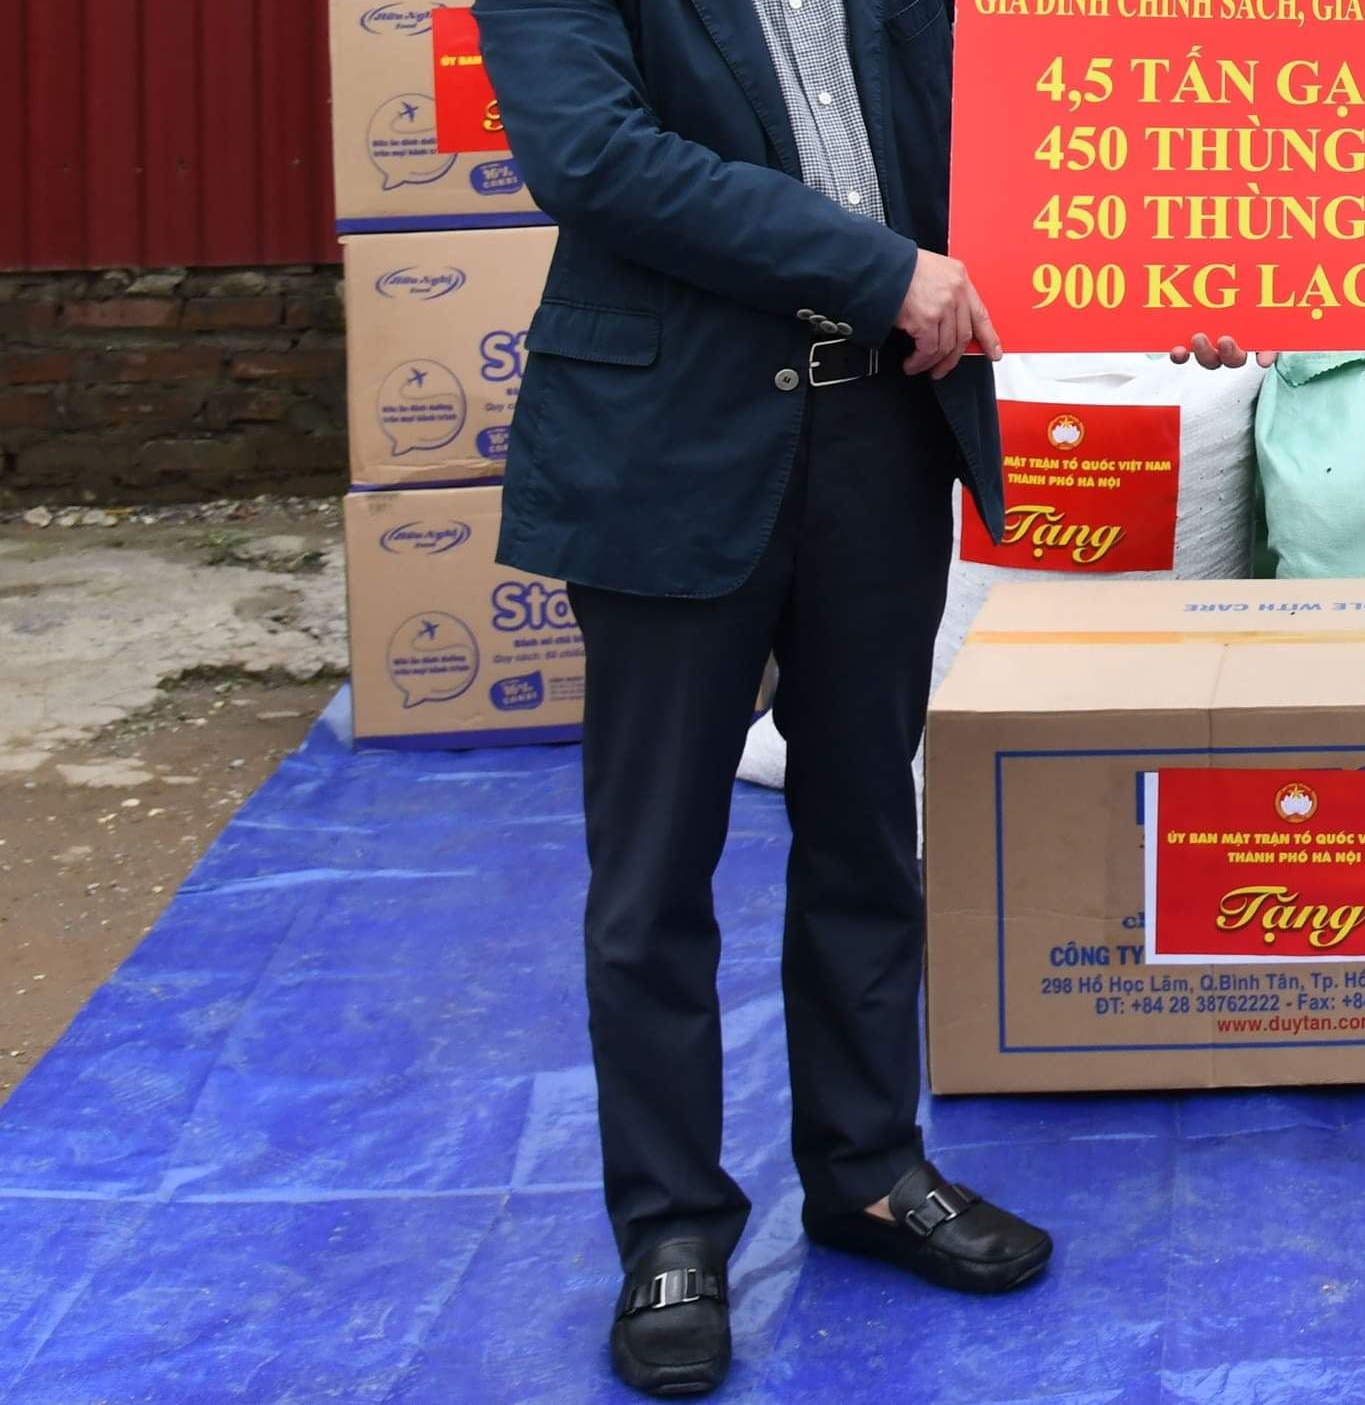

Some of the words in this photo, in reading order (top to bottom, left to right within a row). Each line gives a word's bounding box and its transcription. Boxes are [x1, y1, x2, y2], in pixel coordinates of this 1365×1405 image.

[1036, 56, 1113, 112] 4,5
[1131, 45, 1259, 104] TẤN
[1034, 125, 1128, 171] 450
[1033, 195, 1126, 240] 450
[1032, 264, 1125, 309] 900
[1143, 264, 1240, 308] KG
[1001, 504, 1121, 563] Tặng
[1184, 603, 1249, 612] CARE
[1258, 603, 1322, 611] WITH
[1189, 832, 1218, 844] BAN
[1315, 830, 1355, 845] QUỐC
[1227, 851, 1275, 863] THÀNH
[1278, 849, 1309, 863] PHỐ
[1311, 851, 1332, 863] HÀ
[1335, 850, 1362, 865] NỘI
[1216, 885, 1365, 947] Tặng
[1050, 941, 1110, 966] CÔNG
[1116, 945, 1144, 965] TY
[1041, 978, 1073, 994] 298
[1079, 973, 1103, 993] Hồ
[1109, 975, 1144, 995] Học
[1265, 972, 1305, 992] Tân,
[1311, 972, 1339, 993] Tp.
[1095, 997, 1126, 1015] ĐT:
[1131, 996, 1163, 1013] +84
[1169, 996, 1190, 1013] 28
[1196, 994, 1280, 1013] 38762222
[1298, 993, 1336, 1011] Fax:
